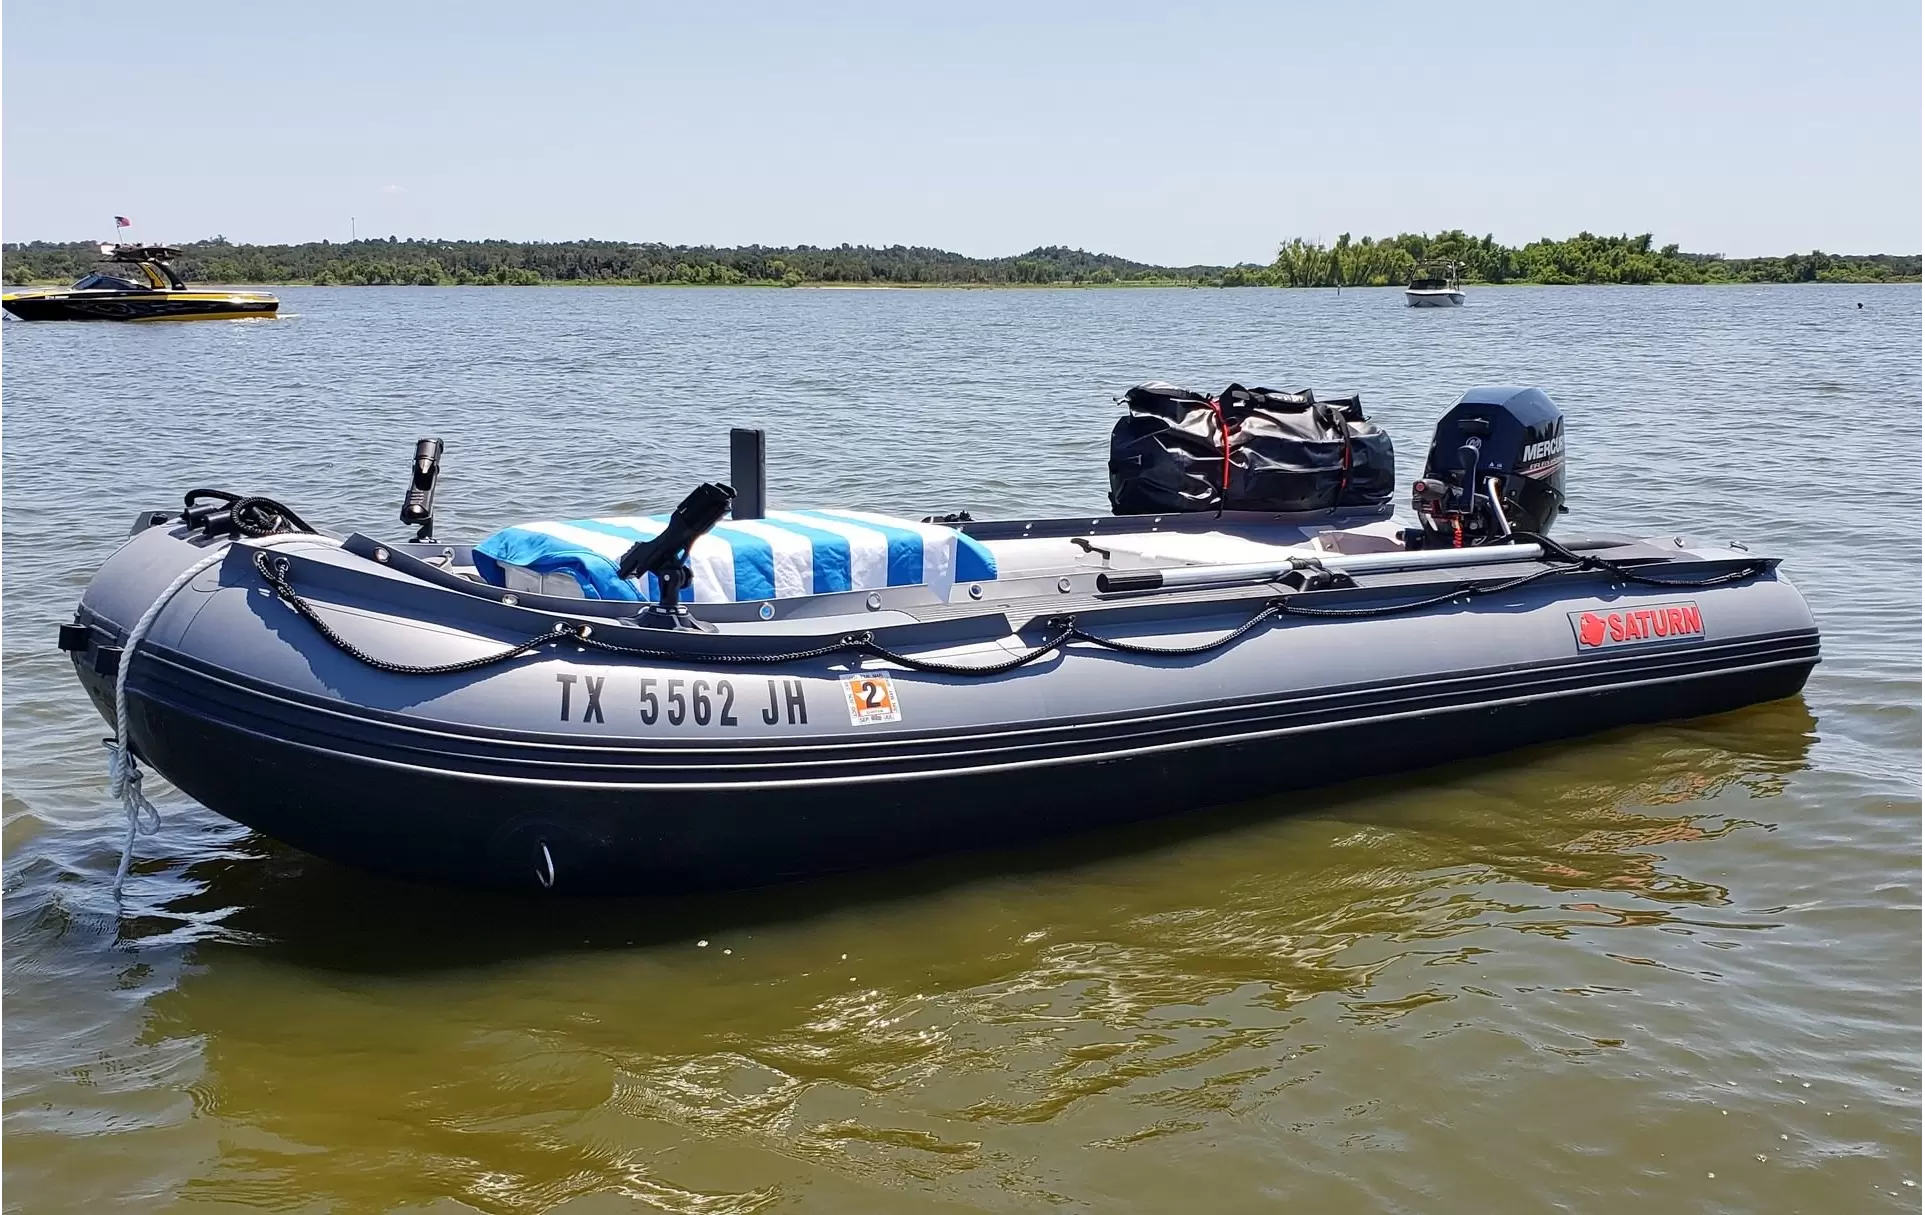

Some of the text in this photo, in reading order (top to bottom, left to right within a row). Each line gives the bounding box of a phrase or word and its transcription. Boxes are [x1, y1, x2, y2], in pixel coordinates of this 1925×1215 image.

[1522, 434, 1564, 462] MERCUR
[1608, 606, 1700, 642] SATURN
[556, 673, 605, 724] TX
[640, 678, 738, 726] 5562
[761, 679, 808, 725] JH
[862, 682, 881, 708] 2
